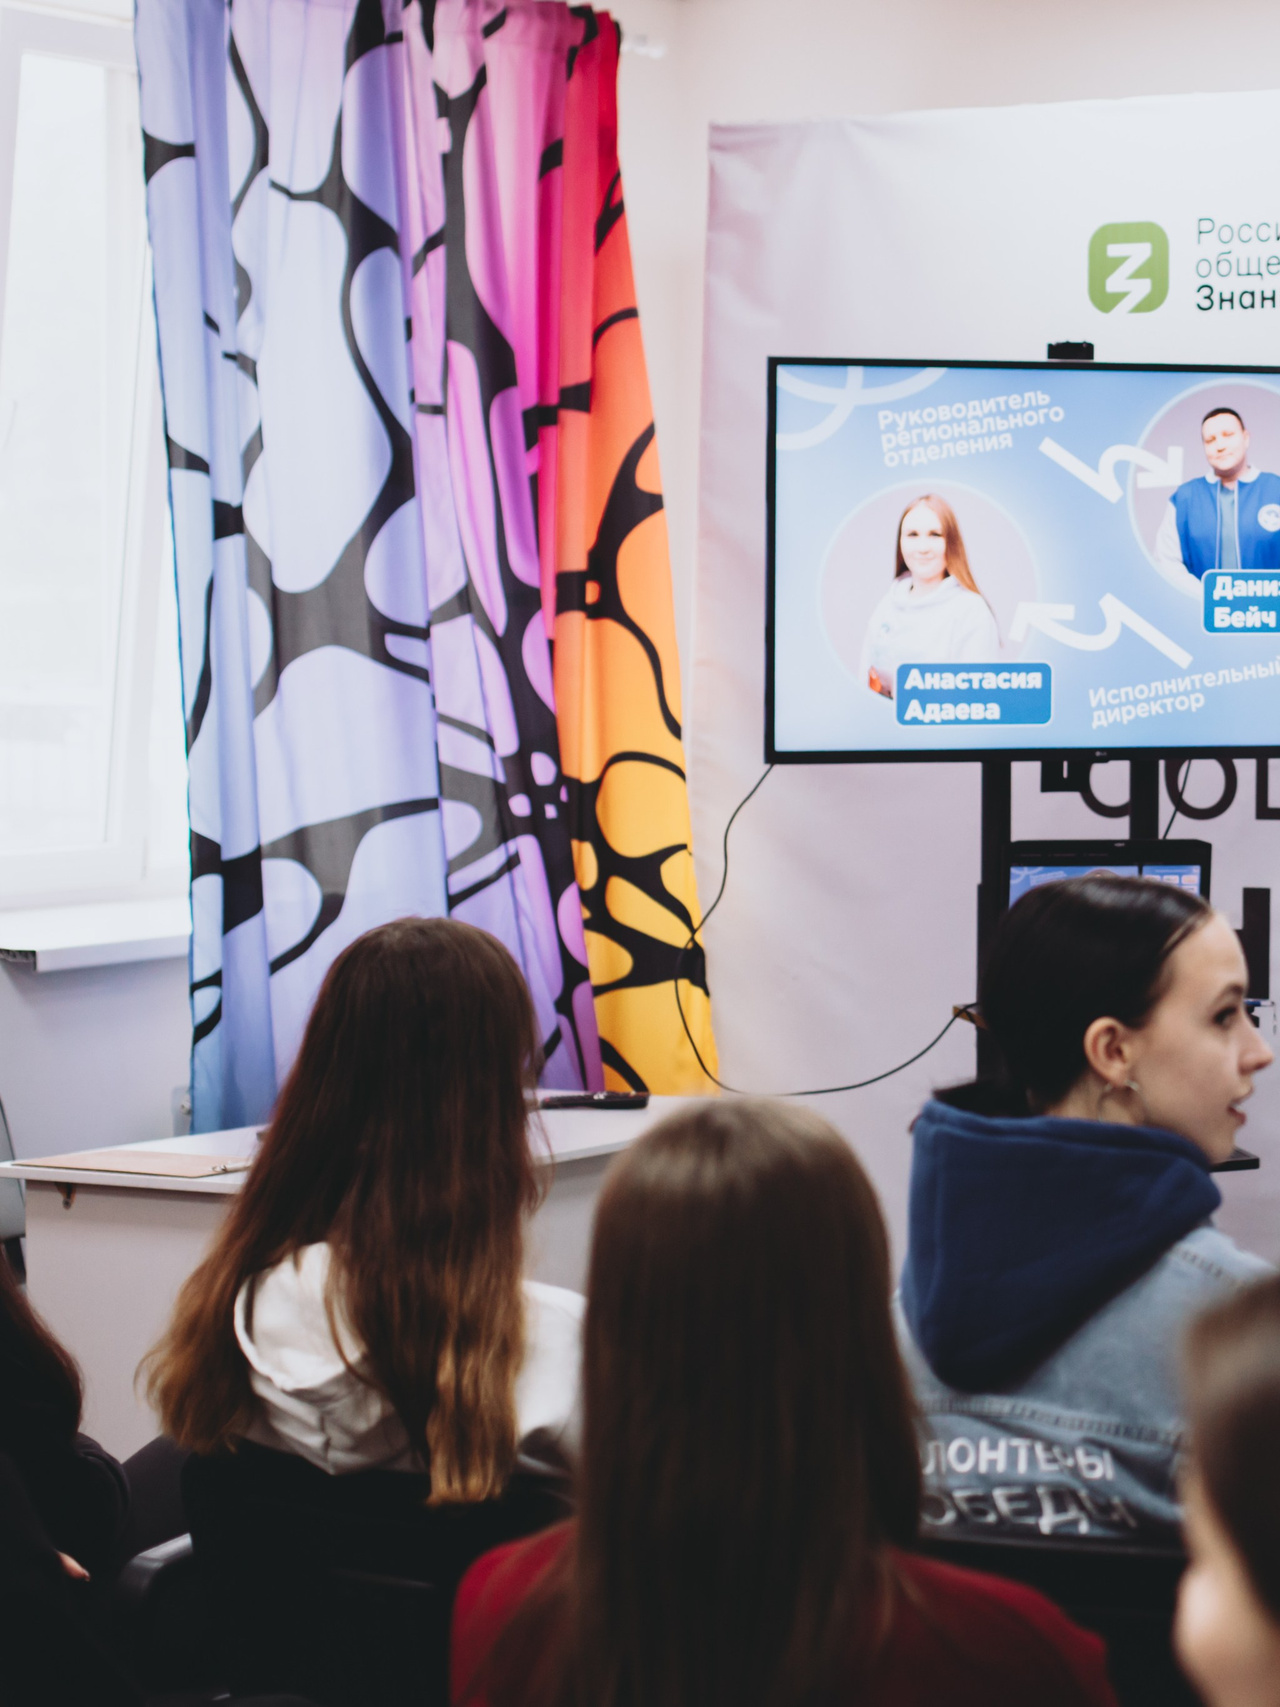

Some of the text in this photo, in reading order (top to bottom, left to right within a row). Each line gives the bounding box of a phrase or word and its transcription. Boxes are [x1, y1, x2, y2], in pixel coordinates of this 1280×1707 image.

[877, 390, 1052, 431] Руководитель
[881, 406, 1065, 452] регионального
[883, 432, 1013, 467] отделения
[1213, 605, 1277, 628] Бейч
[903, 668, 1042, 690] Анастасия
[903, 699, 1001, 723] Адаева
[1092, 692, 1205, 730] директор
